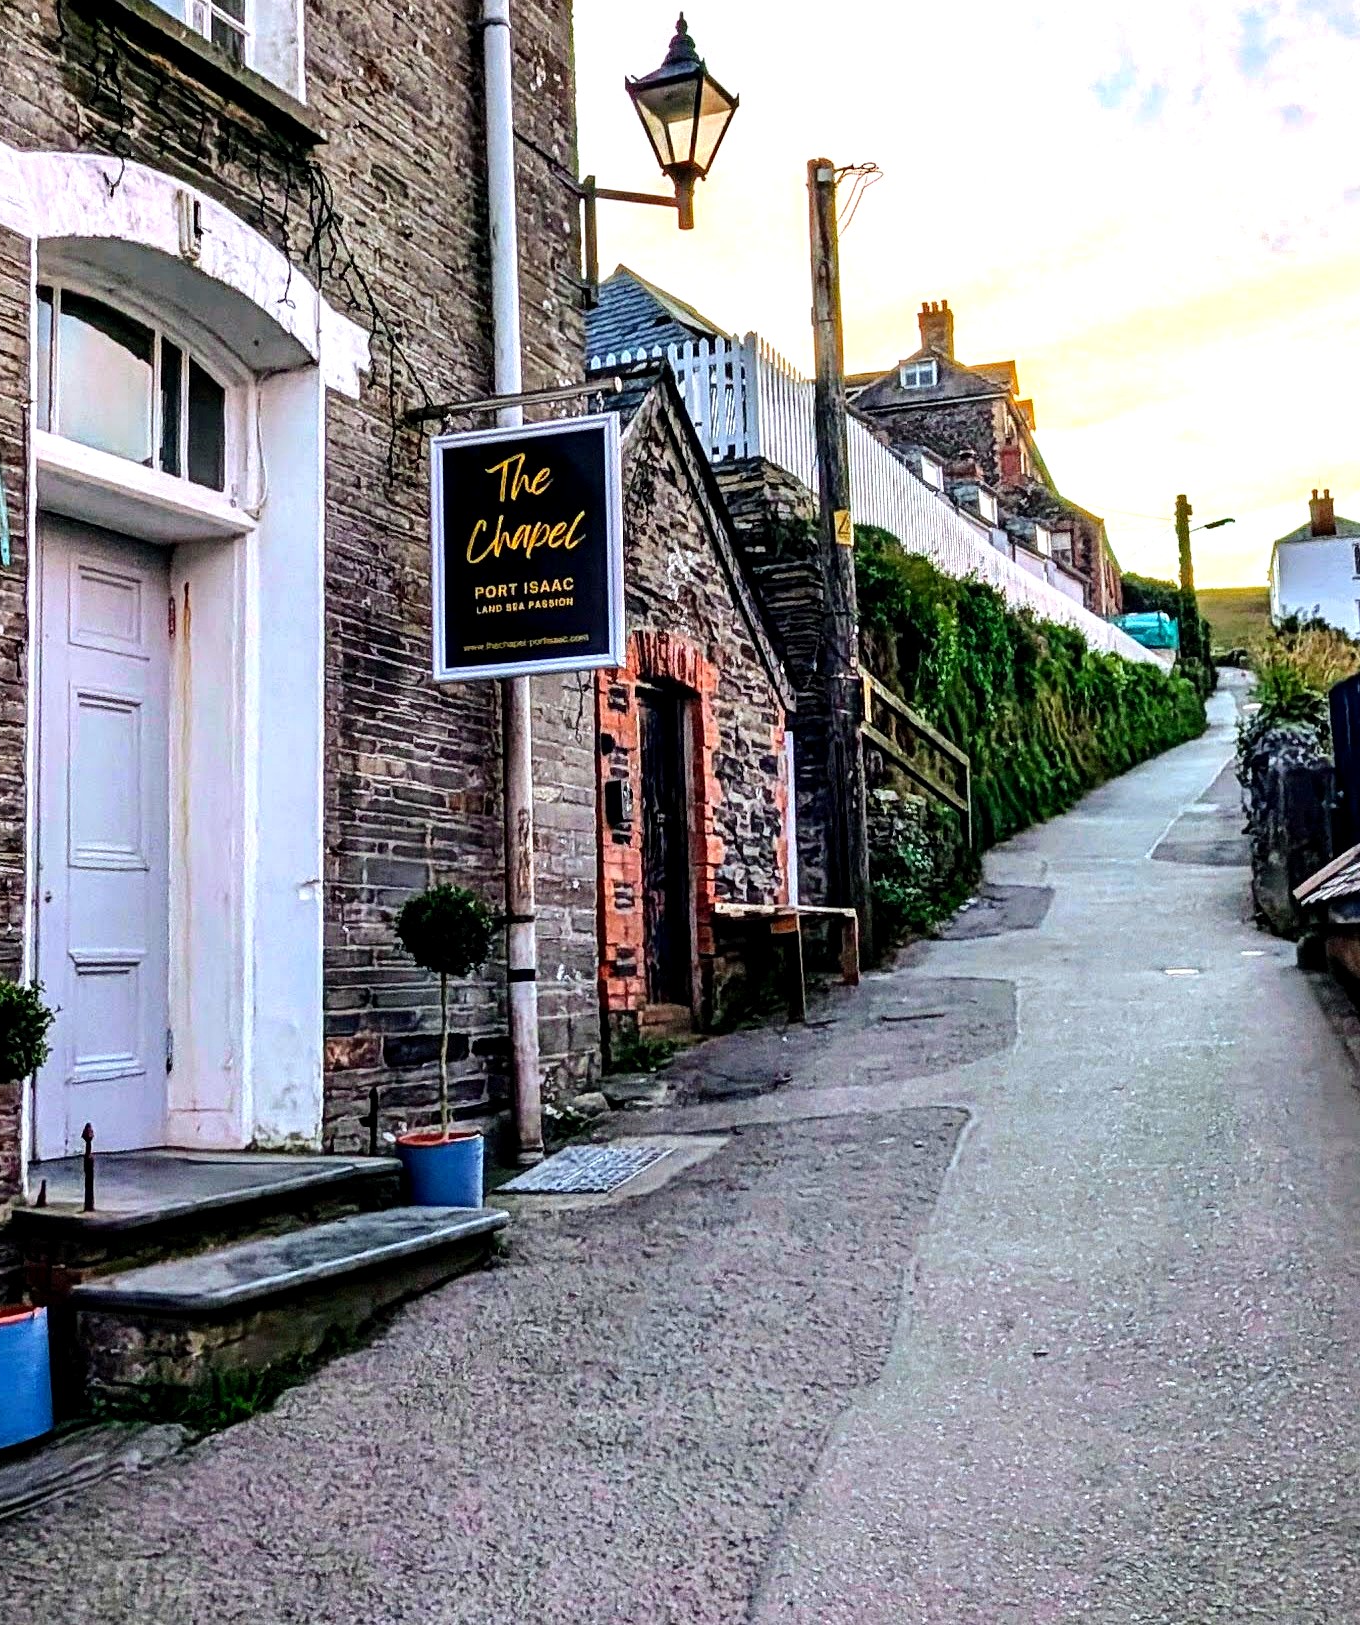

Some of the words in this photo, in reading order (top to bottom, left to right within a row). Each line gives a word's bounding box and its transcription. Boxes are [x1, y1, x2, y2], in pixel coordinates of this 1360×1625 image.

[485, 453, 554, 502] The
[467, 510, 586, 564] Chapel
[475, 583, 518, 600] PORT
[524, 577, 575, 595] ISAAC
[476, 604, 503, 615] LAND
[505, 602, 526, 612] SEA
[528, 597, 574, 609] PASSION
